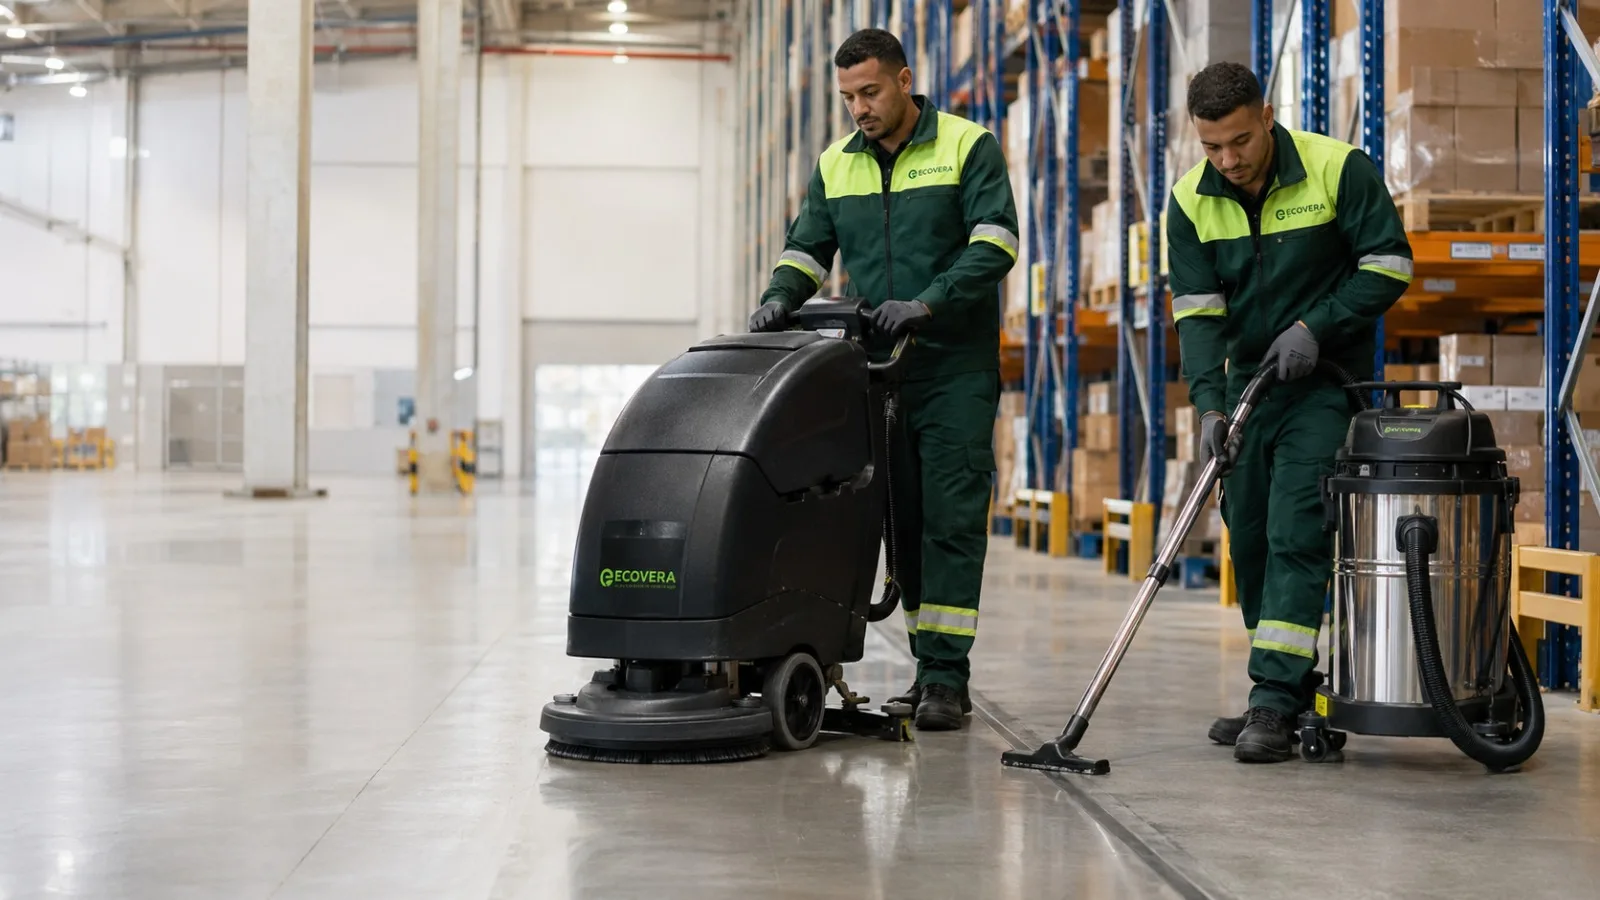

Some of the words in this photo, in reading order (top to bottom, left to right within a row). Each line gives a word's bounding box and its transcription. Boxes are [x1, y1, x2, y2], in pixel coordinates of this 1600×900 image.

[918, 166, 953, 176] ECOVERA
[1286, 203, 1326, 216] ECOVERA
[614, 570, 676, 584] ECOVERA
